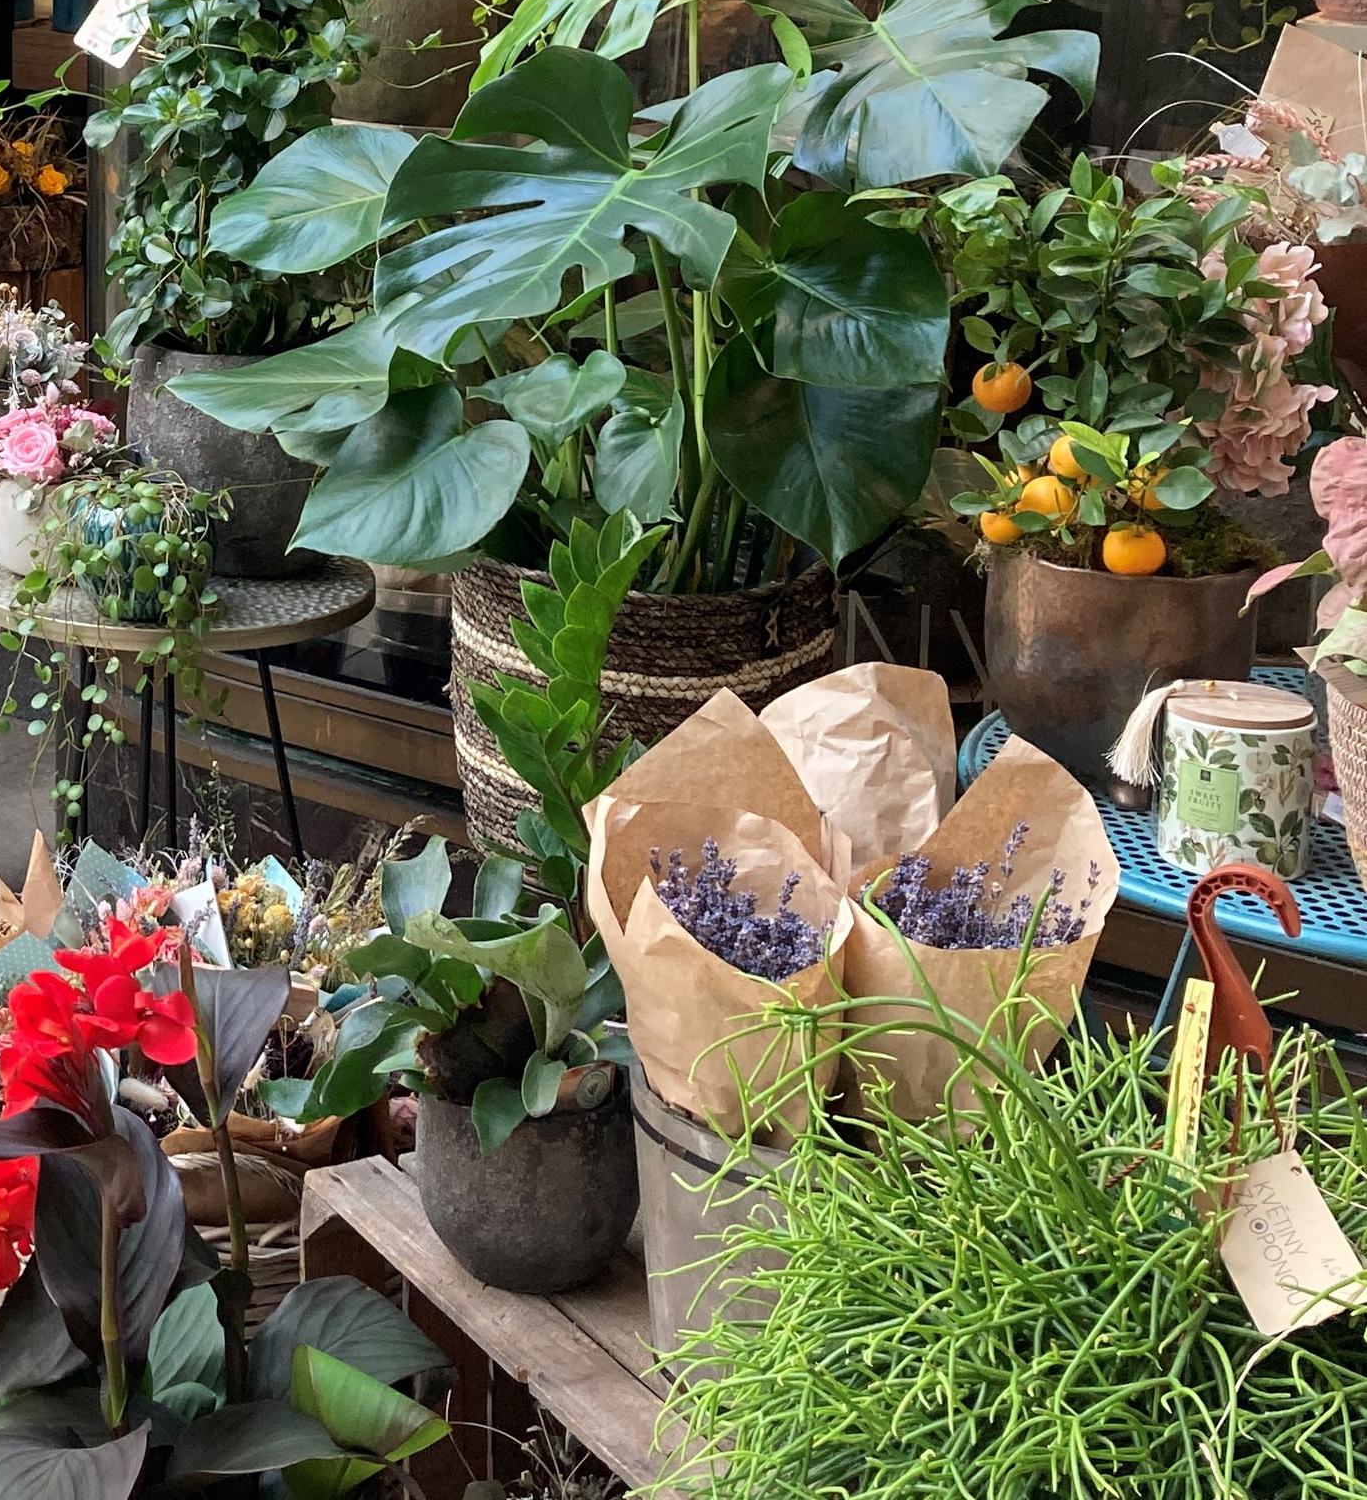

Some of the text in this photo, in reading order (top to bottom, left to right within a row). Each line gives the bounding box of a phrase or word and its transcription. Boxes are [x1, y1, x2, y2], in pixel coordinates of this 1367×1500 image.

[1185, 1010, 1208, 1146] EASYCARE
[1233, 1187, 1308, 1306] ZA OPONOU
[1253, 1180, 1309, 1257] KVĚTINY
